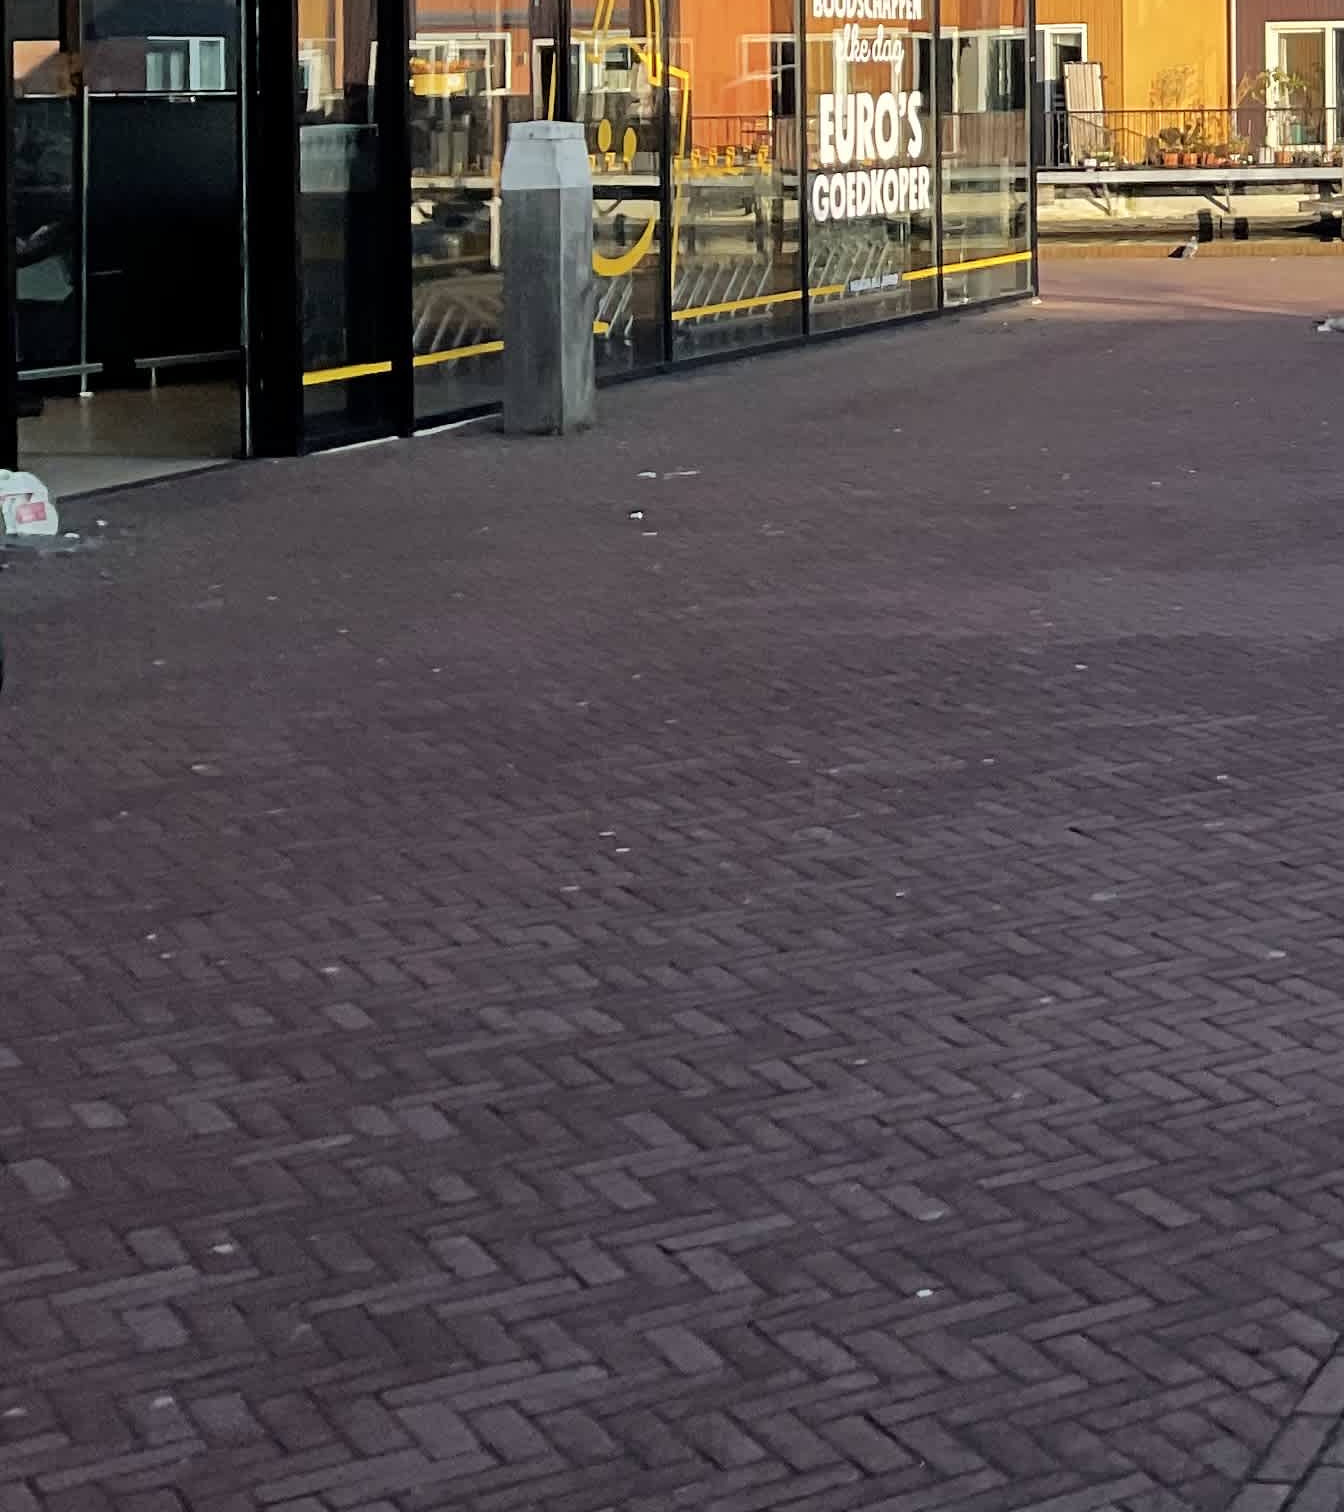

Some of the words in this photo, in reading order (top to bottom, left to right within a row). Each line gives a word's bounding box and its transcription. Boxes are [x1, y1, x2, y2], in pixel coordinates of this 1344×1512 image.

[872, 23, 905, 73] dag
[819, 90, 923, 165] EURO'S
[812, 166, 930, 222] GOEDKOPER
